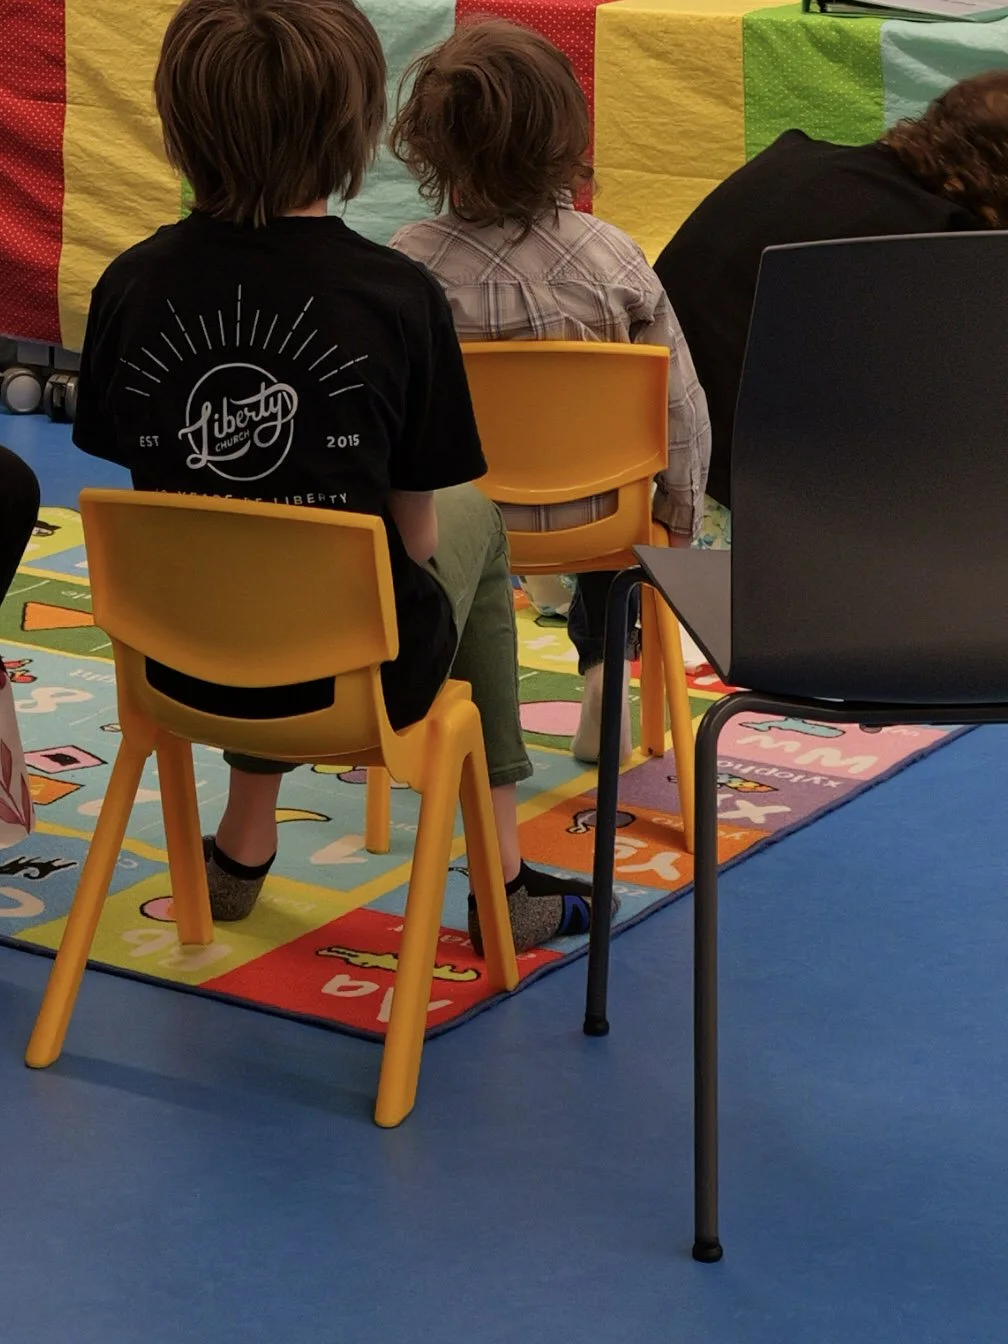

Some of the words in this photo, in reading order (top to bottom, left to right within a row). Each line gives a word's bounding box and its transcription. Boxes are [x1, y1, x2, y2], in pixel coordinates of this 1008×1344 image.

[178, 381, 299, 470] Liberty
[140, 435, 160, 448] EST
[215, 429, 250, 452] CHURCH
[326, 434, 360, 448] 2015
[717, 760, 845, 788] xylopho
